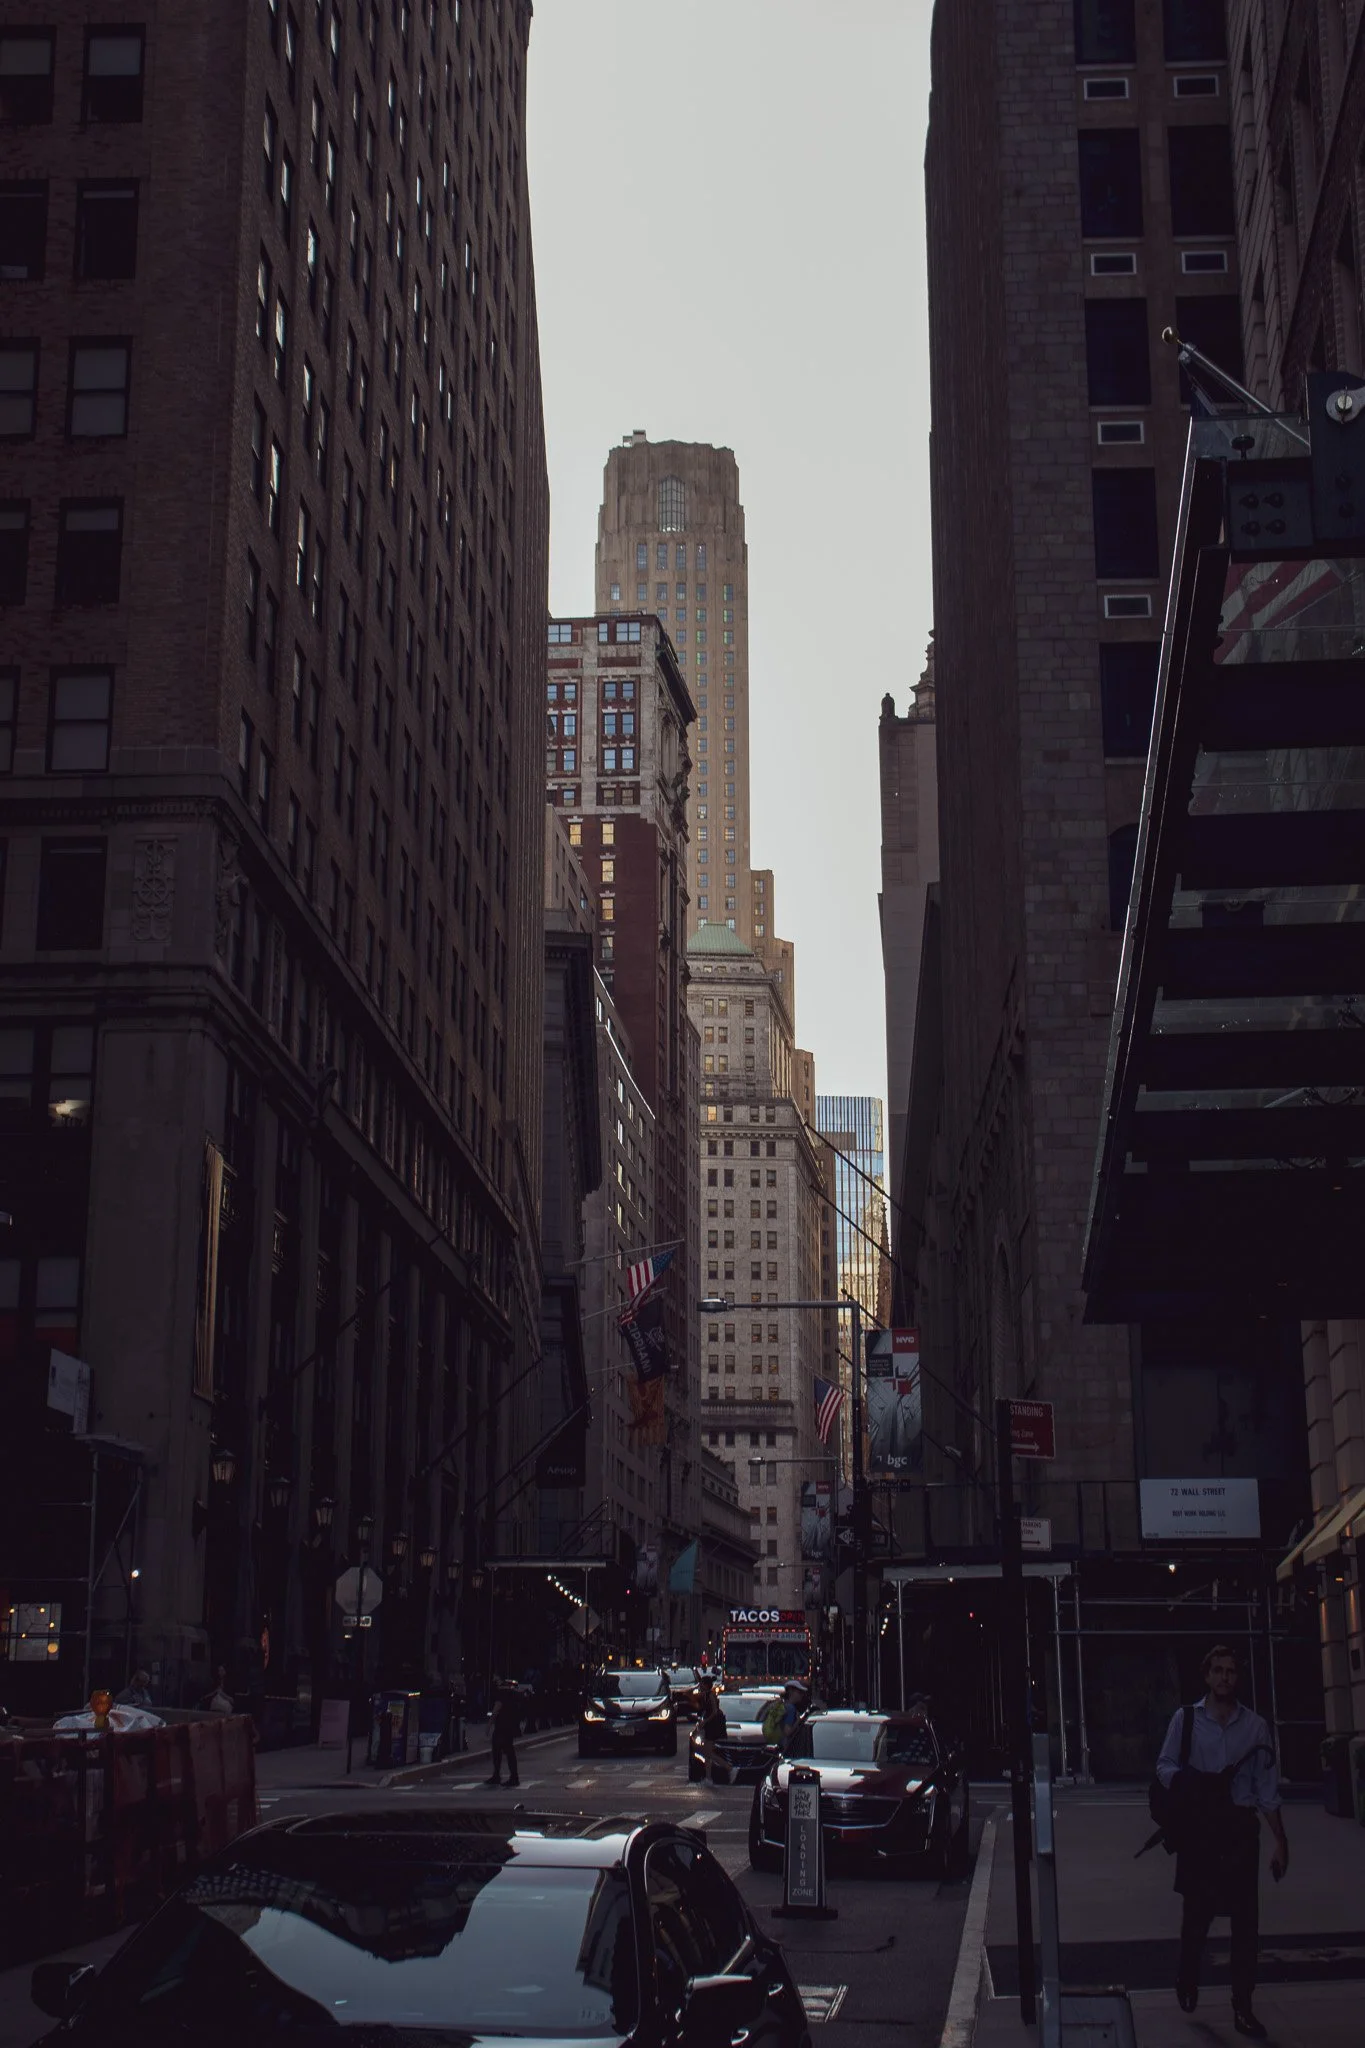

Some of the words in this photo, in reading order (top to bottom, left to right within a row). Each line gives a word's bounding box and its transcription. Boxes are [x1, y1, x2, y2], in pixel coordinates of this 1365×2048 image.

[896, 1336, 915, 1344] NYC
[1010, 1404, 1044, 1418] STANDING
[887, 1453, 908, 1469] bgc
[1171, 1488, 1179, 1496] 72
[1181, 1488, 1199, 1497] WALL
[1202, 1488, 1226, 1497] STREET
[730, 1610, 780, 1623] TACOS
[799, 1825, 807, 1887] LOADING
[792, 1888, 815, 1897] ZONE
